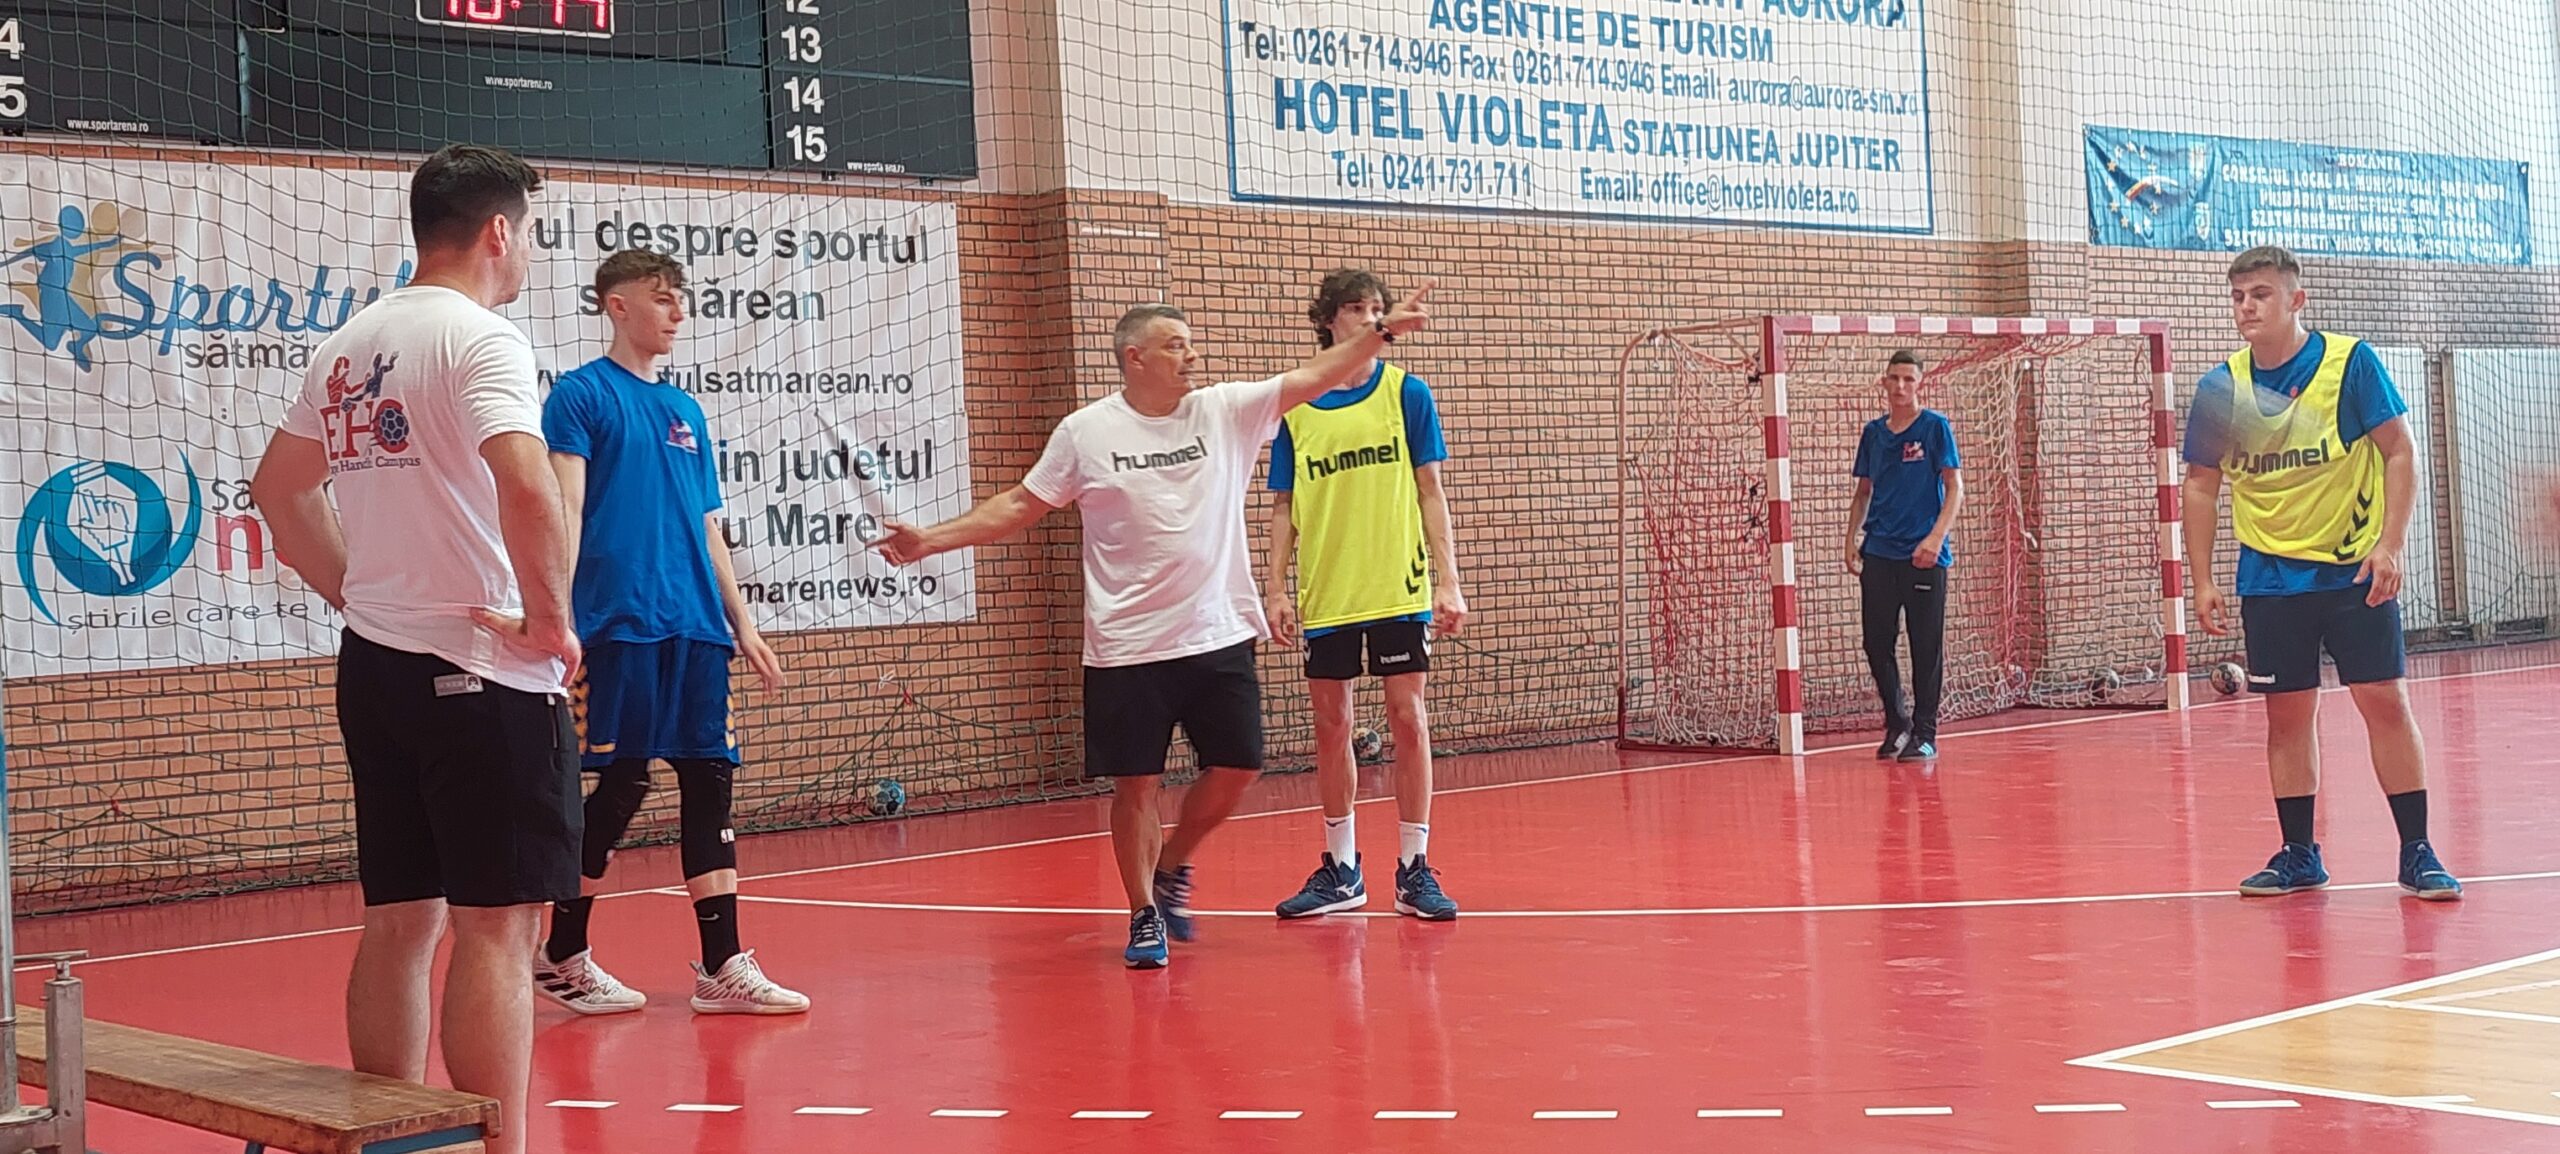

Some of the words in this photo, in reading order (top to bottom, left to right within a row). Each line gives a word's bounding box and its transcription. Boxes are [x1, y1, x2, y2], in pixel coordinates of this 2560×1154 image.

[781, 25, 822, 63] 13
[1597, 11, 1641, 49] DE
[1650, 17, 1774, 63] TURISM
[1239, 20, 1285, 61] Tel:
[1460, 44, 1506, 82] Fax:
[1661, 64, 1721, 101] Email:
[784, 76, 825, 114] 14
[67, 119, 149, 132] www.sportarena.ro
[786, 125, 828, 162] 15
[1274, 77, 1424, 141] HOTEL
[1438, 91, 1615, 154] VIOLETA
[1790, 131, 1901, 172] JUPITER
[1332, 150, 1374, 189] Tel:
[1580, 167, 1643, 203] Email:
[1651, 172, 1858, 214] office@hotelvioleta.ro
[2294, 169, 2333, 189] LOCAL
[2336, 172, 2350, 190] AL
[595, 210, 760, 266] despre
[774, 225, 929, 267] sportul
[579, 276, 825, 322] sărean
[184, 333, 317, 369] sătmă
[775, 439, 933, 494] județul
[1111, 435, 1208, 473] hummel
[1306, 435, 1400, 481] hummel
[2230, 438, 2330, 474] hummel
[766, 503, 877, 549] Mare
[737, 573, 937, 605] marenews.ro
[186, 607, 261, 625] care
[273, 600, 309, 620] te
